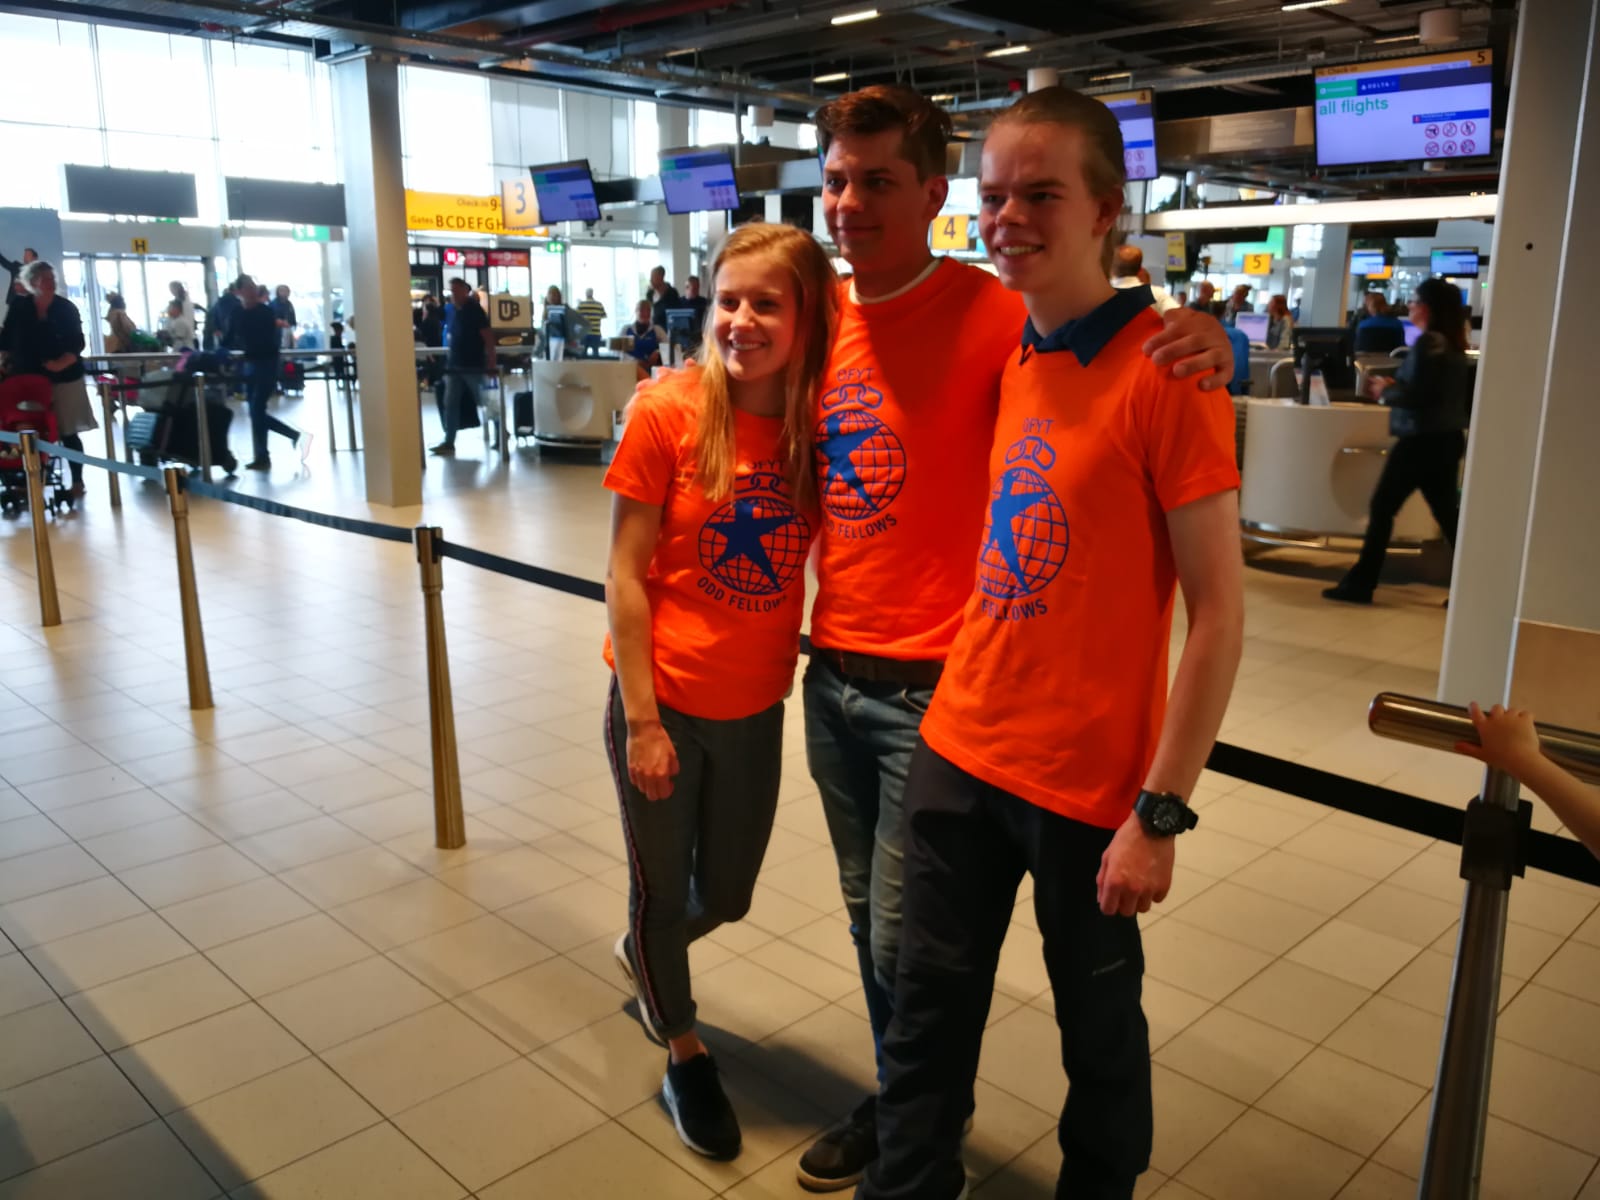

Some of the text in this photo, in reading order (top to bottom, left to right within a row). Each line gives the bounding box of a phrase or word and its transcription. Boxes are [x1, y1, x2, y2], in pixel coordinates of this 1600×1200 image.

[1477, 51, 1486, 64] 5
[1320, 97, 1389, 116] all flights
[515, 182, 527, 215] 3
[943, 216, 956, 240] 4
[135, 240, 145, 252] H
[1253, 254, 1262, 269] 5
[837, 367, 875, 382] OFYT
[838, 513, 897, 540] FELLOWS
[697, 576, 725, 601] ODD
[981, 598, 1048, 622] FELLOWS
